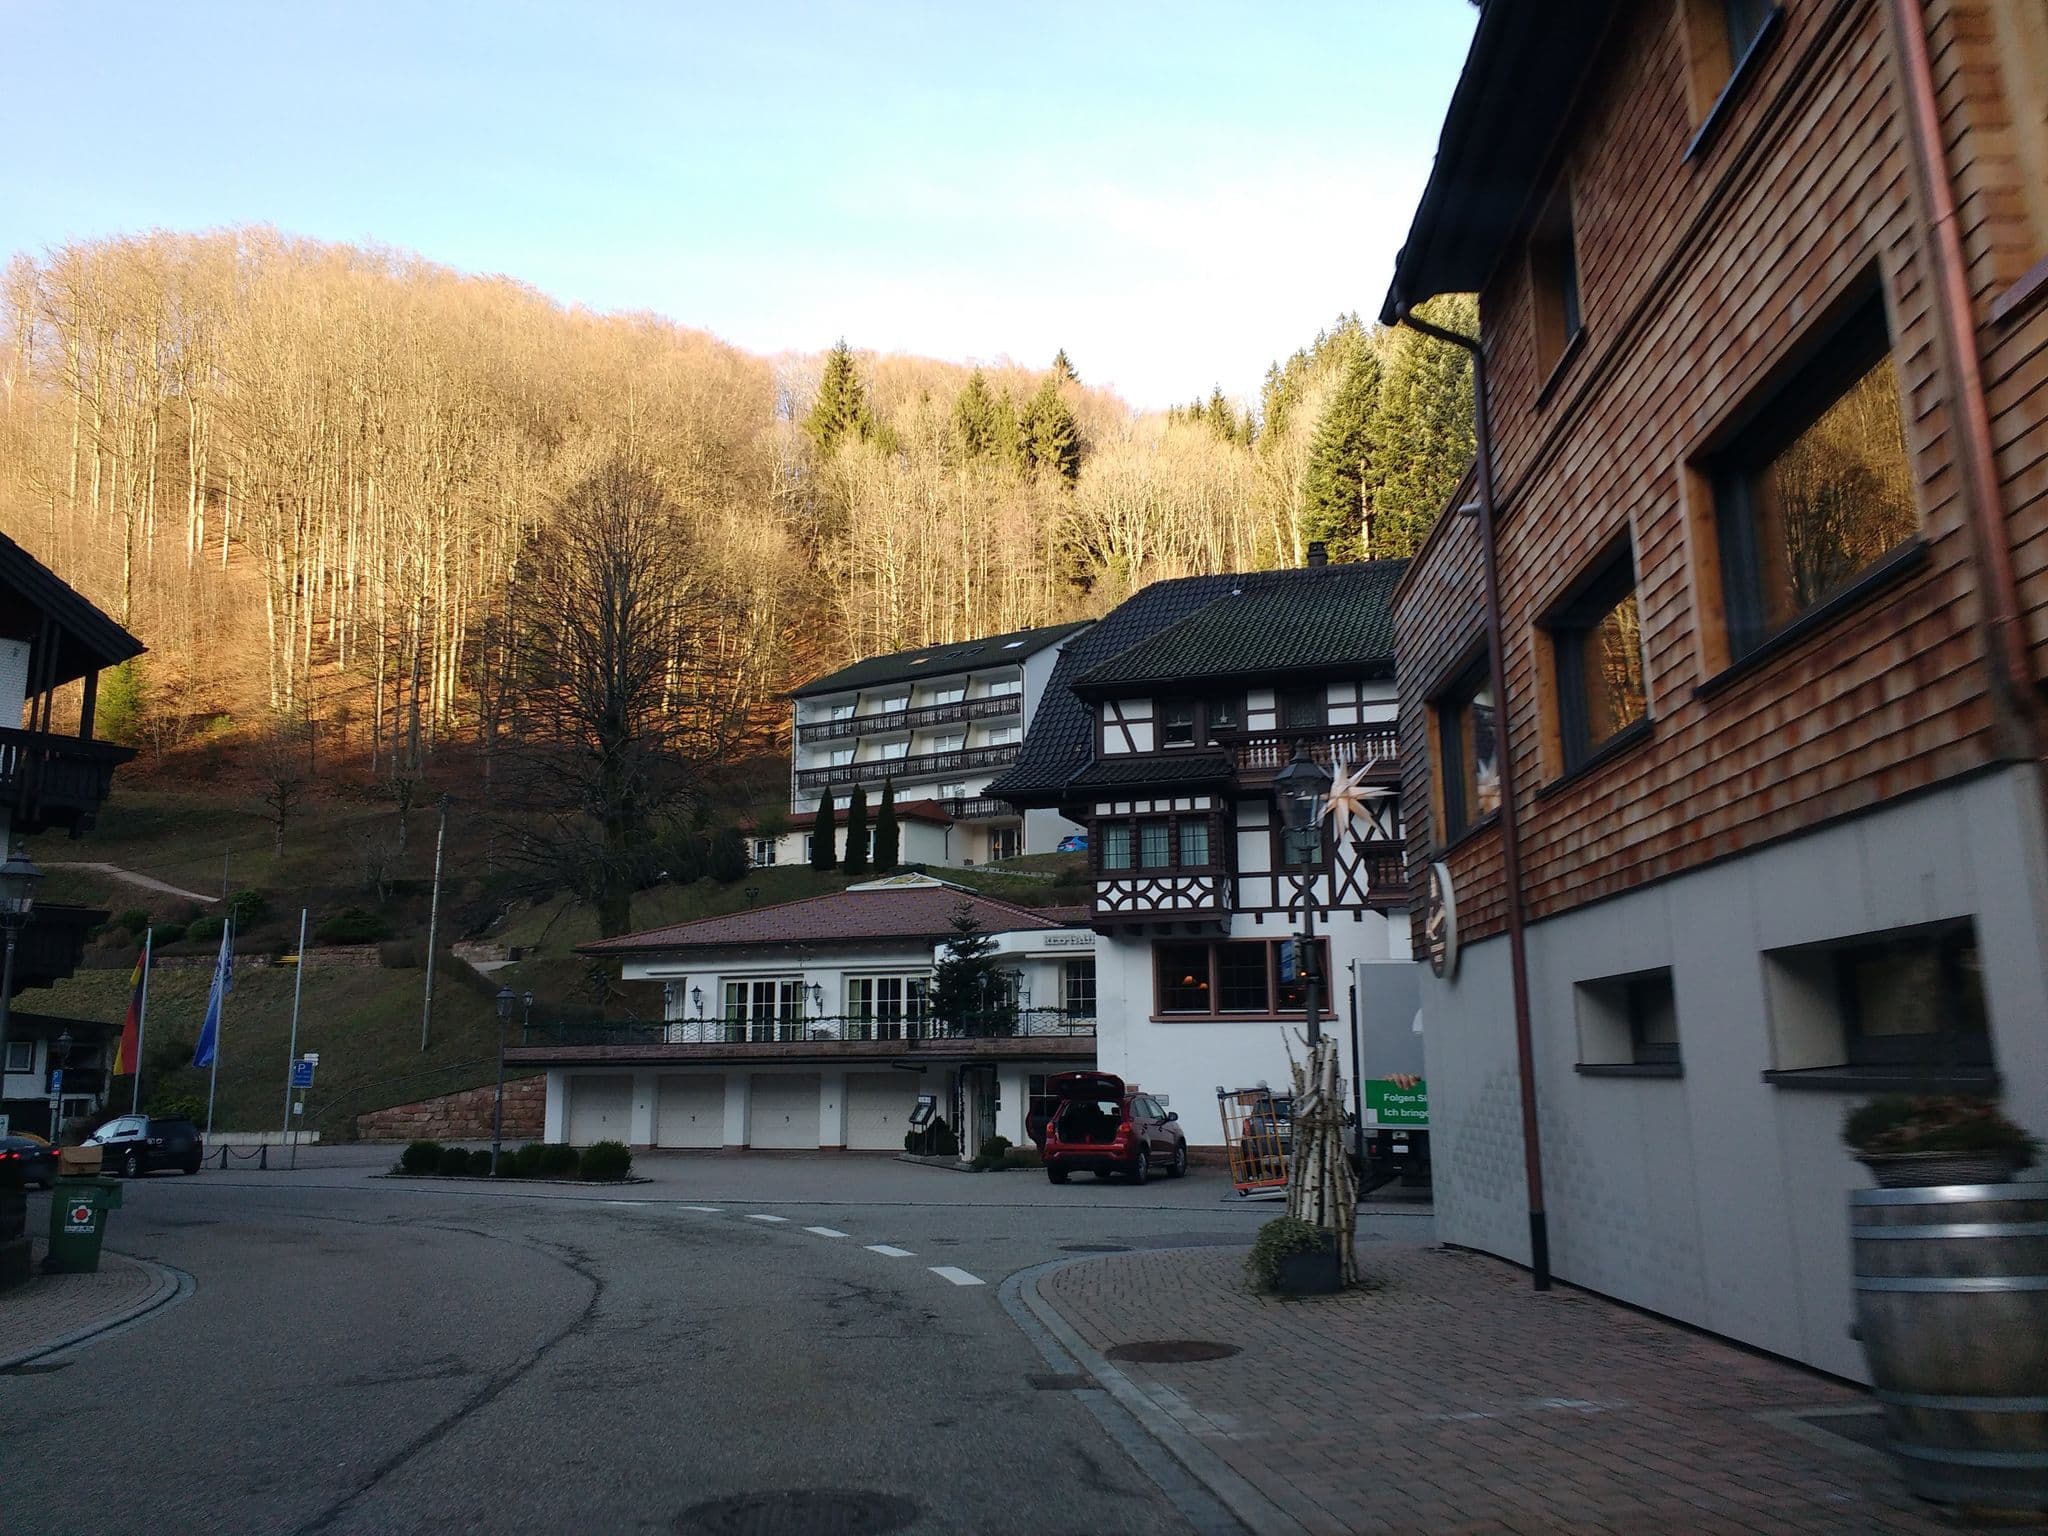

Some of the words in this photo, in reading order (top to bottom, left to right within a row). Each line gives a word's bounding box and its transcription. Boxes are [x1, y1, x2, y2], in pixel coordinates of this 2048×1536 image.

[298, 1064, 306, 1073] P
[1384, 1093, 1416, 1104] Folgen
[1384, 1108, 1399, 1116] Ich
